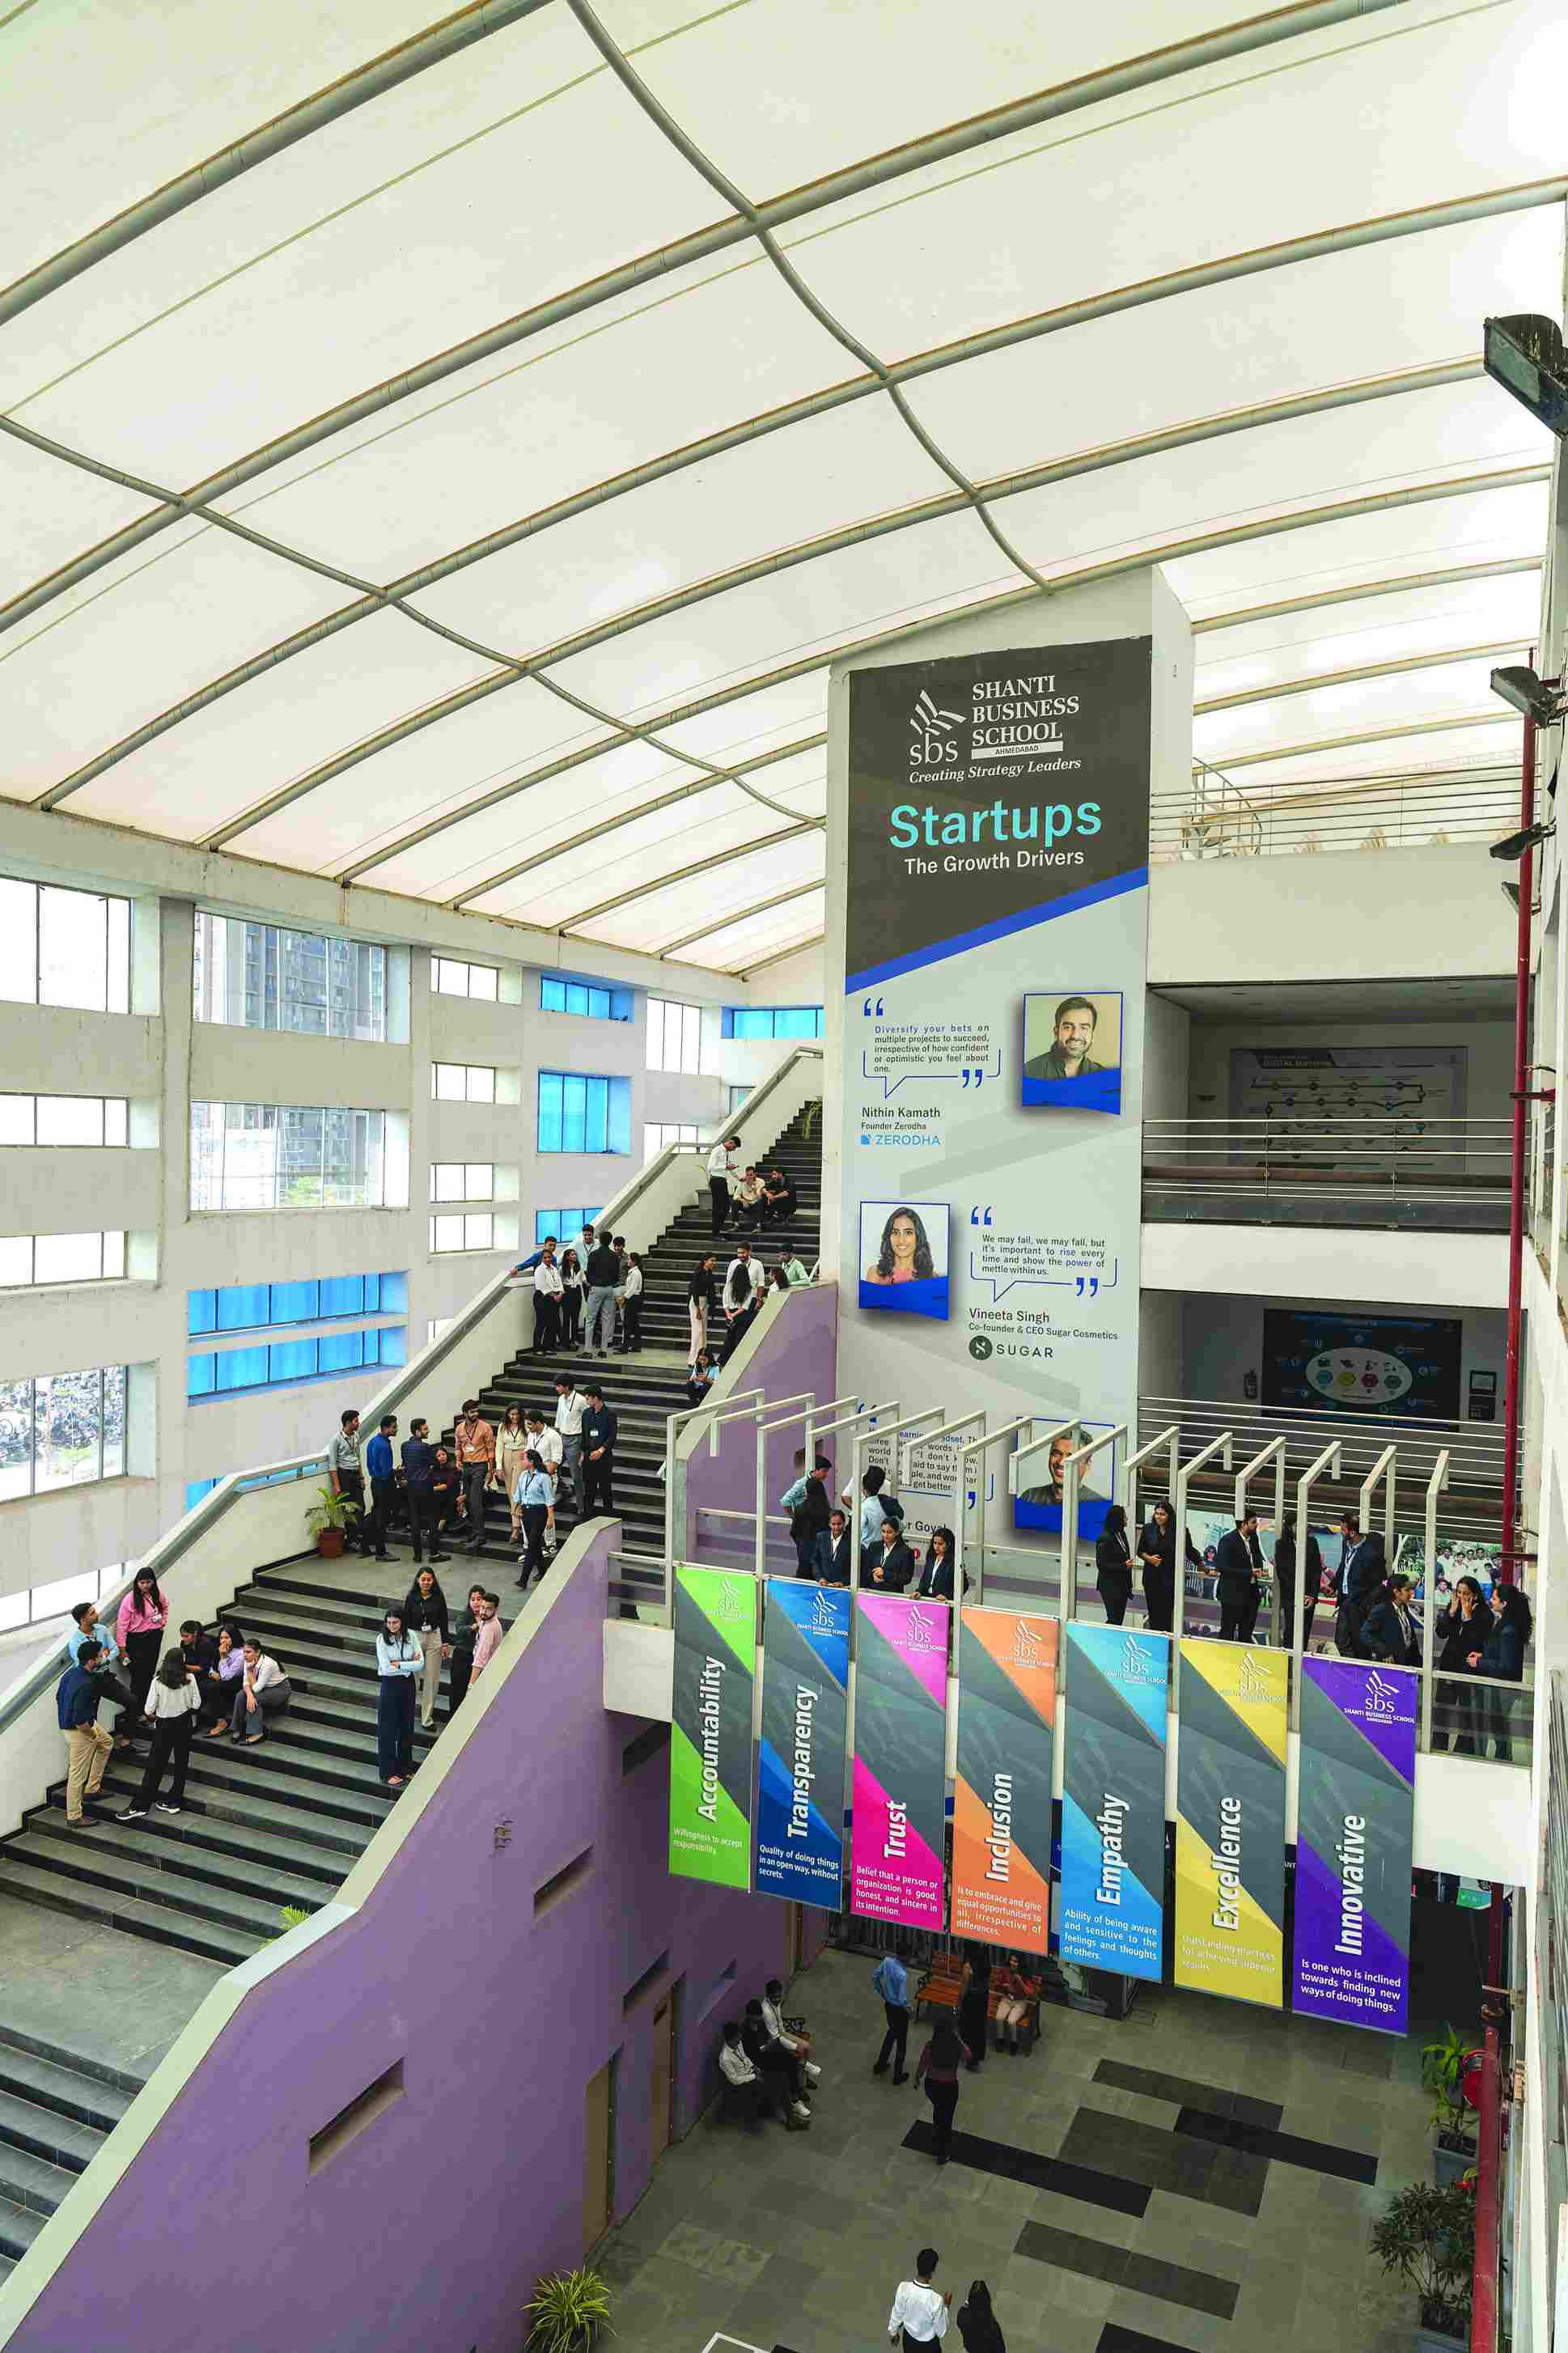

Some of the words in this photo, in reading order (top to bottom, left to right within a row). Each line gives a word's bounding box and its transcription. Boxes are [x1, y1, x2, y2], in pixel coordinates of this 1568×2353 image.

[973, 676, 1055, 700] SHANTI
[973, 697, 1079, 723] BUSINESS
[973, 722, 1062, 746] SCHOOL
[910, 732, 958, 765] sbs
[995, 745, 1039, 755] AHMEDABAD
[910, 769, 964, 783] Creating
[968, 765, 1023, 778] Strategy
[1028, 758, 1081, 773] Leaders
[890, 800, 1101, 847] Startups
[905, 858, 938, 874] The
[943, 852, 1010, 873] Growth
[1017, 850, 1084, 867] Drivers
[875, 1025, 918, 1034] Diversify
[924, 1026, 945, 1034] your
[875, 1045, 919, 1054] irrespective
[887, 1055, 924, 1063] optimistic
[862, 1107, 893, 1117] Nithin
[898, 1107, 939, 1117] Kamath
[875, 1134, 939, 1145] ZERODHA
[1001, 1246, 1040, 1255] important
[1082, 1250, 1104, 1258] every
[1091, 1239, 1104, 1247] but
[1011, 1266, 1035, 1274] within
[1023, 1257, 1045, 1265] show
[1049, 1257, 1062, 1266] the
[1066, 1259, 1092, 1267] power
[970, 1308, 1012, 1320] Vineeta
[1017, 1311, 1049, 1325] Singh
[969, 1322, 1014, 1333] Co-founder
[1047, 1328, 1070, 1337] Sugar
[1073, 1329, 1118, 1339] Cosmetics
[996, 1344, 1053, 1358] SUGAR
[812, 1611, 833, 1626] sbs
[1366, 1694, 1395, 1712] sbs
[1392, 1715, 1415, 1723] SCHOOL
[697, 1656, 726, 1822] Accountability
[787, 1683, 818, 1838] Transparency
[884, 1800, 907, 1859] Trust
[985, 1773, 1012, 1883] Inclusion
[760, 1845, 784, 1859] Quality
[786, 1851, 793, 1859] of
[795, 1852, 815, 1865] doing
[817, 1858, 838, 1870] things
[1096, 1793, 1130, 1906] Empathy
[777, 1860, 793, 1870] open
[810, 1868, 838, 1880] without
[857, 1865, 877, 1876] Belief
[879, 1871, 893, 1880] that
[903, 1876, 927, 1886] person
[1212, 1797, 1241, 1931] Excellence
[857, 1879, 901, 1893] organization
[906, 1887, 912, 1895] is
[1334, 1814, 1366, 1957] Innovative
[901, 1898, 927, 1910] sincere
[930, 1904, 937, 1912] in
[958, 1897, 978, 1908] equal
[980, 1902, 1031, 1919] opportunities
[1034, 1914, 1041, 1923] to
[965, 1888, 973, 1896] to
[975, 1890, 1007, 1904] embrace
[1009, 1897, 1023, 1907] and
[1024, 1901, 1041, 1911] give
[1065, 1910, 1091, 1923] Ability
[1094, 1915, 1103, 1923] of
[1105, 1917, 1128, 1930] being
[1131, 1923, 1157, 1935] aware
[1065, 1922, 1080, 1931] and
[1087, 1927, 1123, 1940] sensitive
[1129, 1935, 1138, 1943] to
[1143, 1938, 1157, 1948] the
[1065, 1931, 1096, 1948] feelings
[1100, 1941, 1116, 1950] and
[1120, 1945, 1156, 1960] thoughts
[1302, 1958, 1309, 1968] Is
[1312, 1963, 1329, 1973] one
[1331, 1965, 1351, 1977] who
[1354, 1969, 1362, 1978] is
[1364, 1971, 1401, 1987] inclined
[1301, 1972, 1338, 1986] towards
[1342, 1980, 1375, 1997] finding
[1380, 1990, 1401, 1999] new
[1301, 1986, 1324, 1997] ways
[1326, 1990, 1335, 1999] of
[1337, 1992, 1362, 2007] doing
[1364, 1998, 1396, 2012] things.
